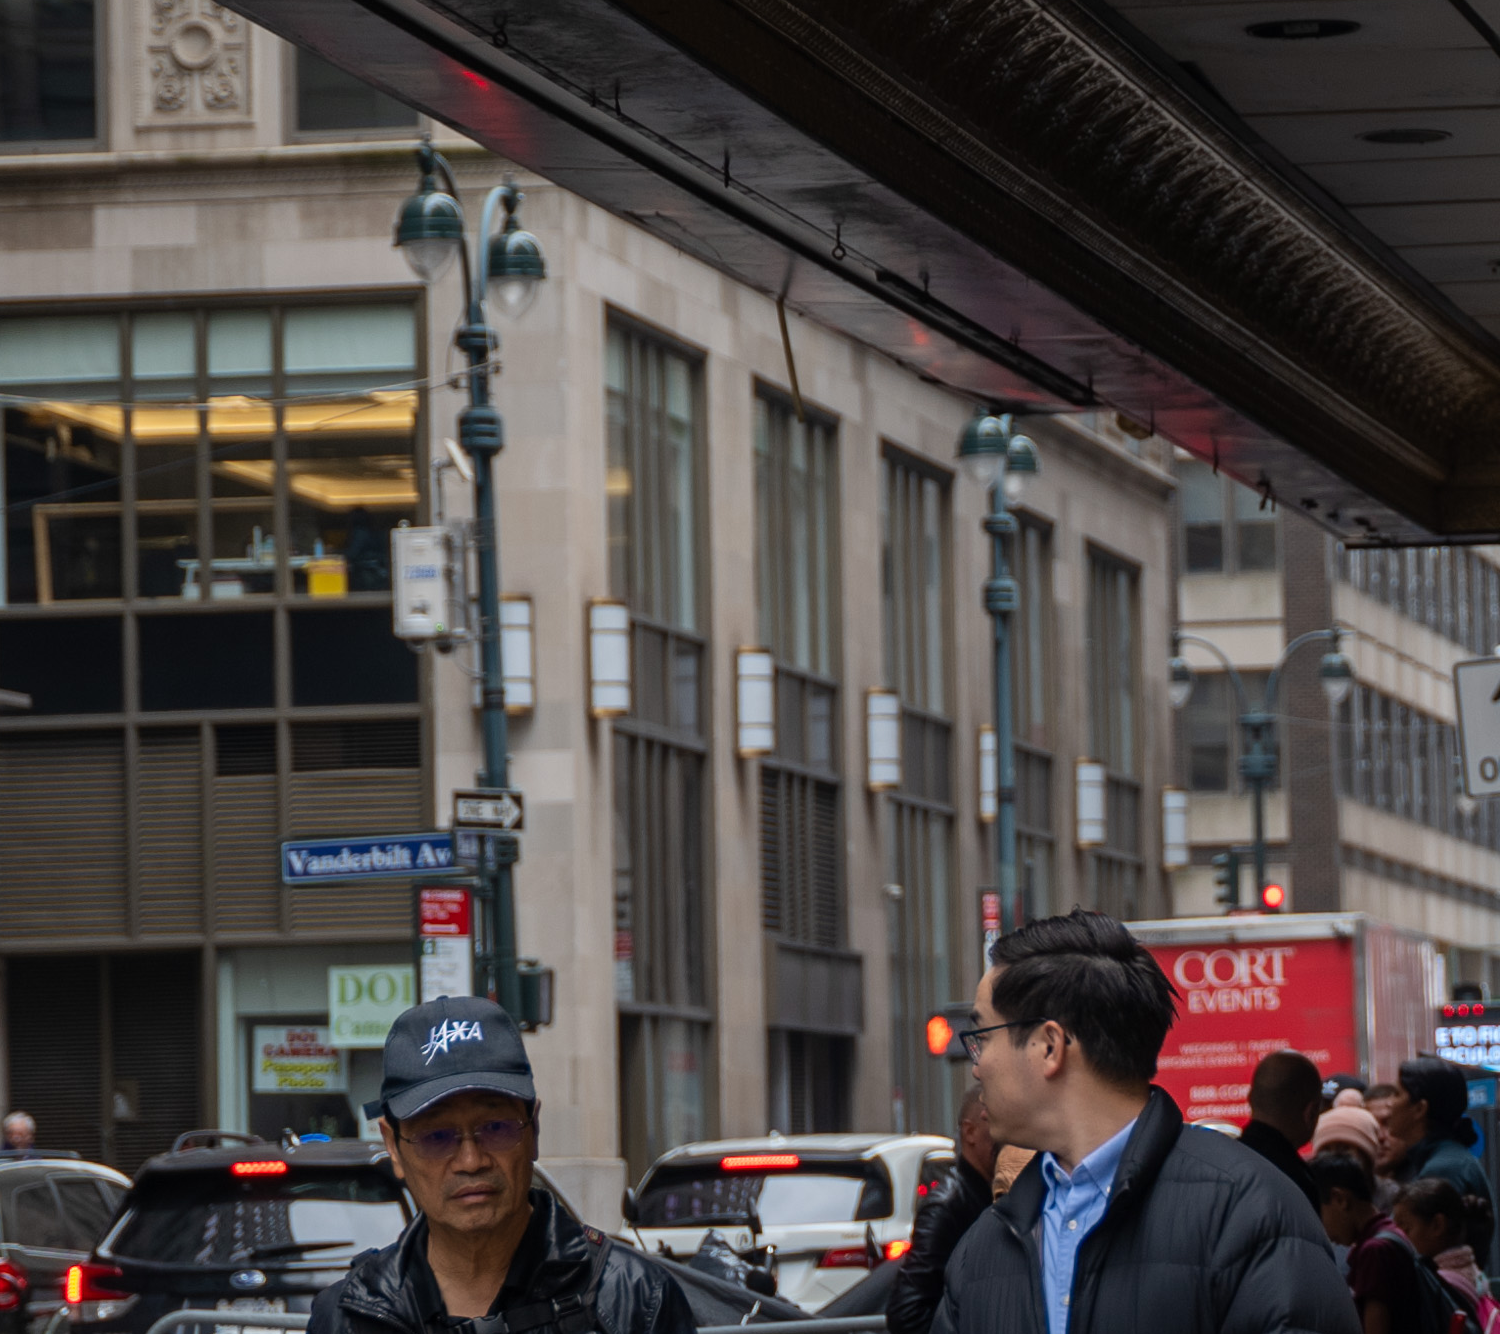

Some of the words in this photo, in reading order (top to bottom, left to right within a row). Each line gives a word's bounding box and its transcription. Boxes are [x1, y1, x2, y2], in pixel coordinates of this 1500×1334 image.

[288, 844, 411, 875] Vanderbilt
[1173, 947, 1288, 990] CORT
[1188, 987, 1280, 1013] EVENTS
[335, 1016, 392, 1036] Came
[263, 1043, 338, 1057] CAMERA
[420, 1018, 484, 1066] JAXA
[262, 1059, 339, 1075] Passport
[277, 1076, 326, 1088] Photo
